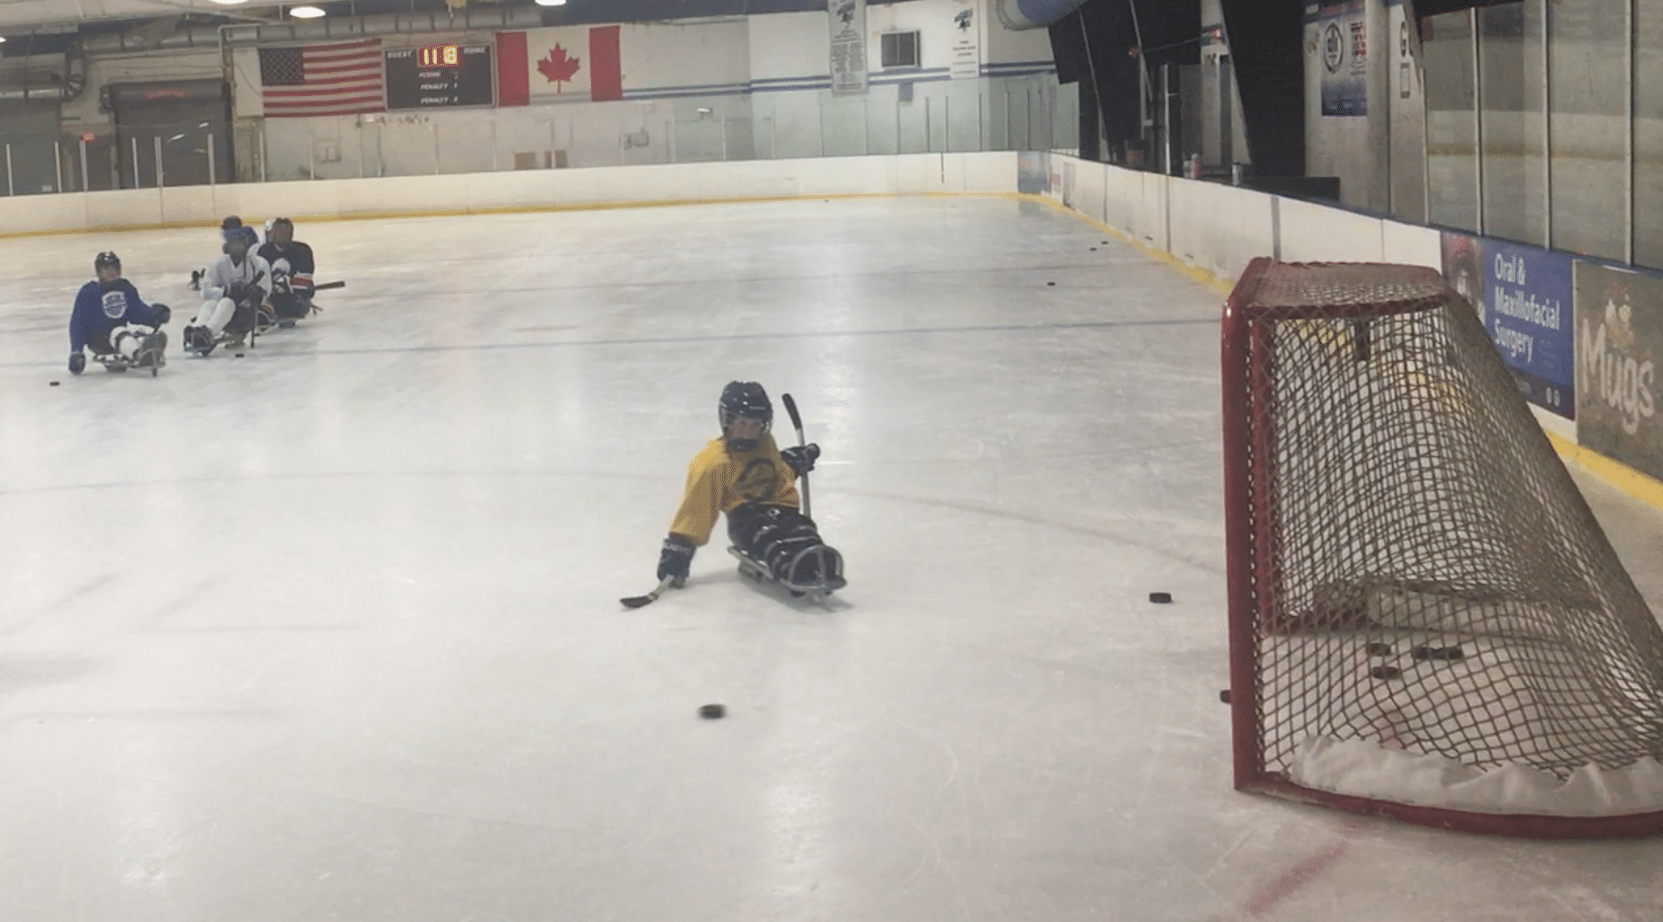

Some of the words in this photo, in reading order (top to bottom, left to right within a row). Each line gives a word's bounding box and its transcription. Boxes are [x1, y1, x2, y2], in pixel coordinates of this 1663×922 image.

[420, 82, 448, 90] PENALTY
[420, 96, 449, 104] PENALTY
[1494, 252, 1516, 283] Oral
[1517, 257, 1526, 286] &
[1494, 285, 1560, 331] Maxillofacial
[1494, 318, 1534, 364] Surgery
[1582, 318, 1655, 436] Mugs
